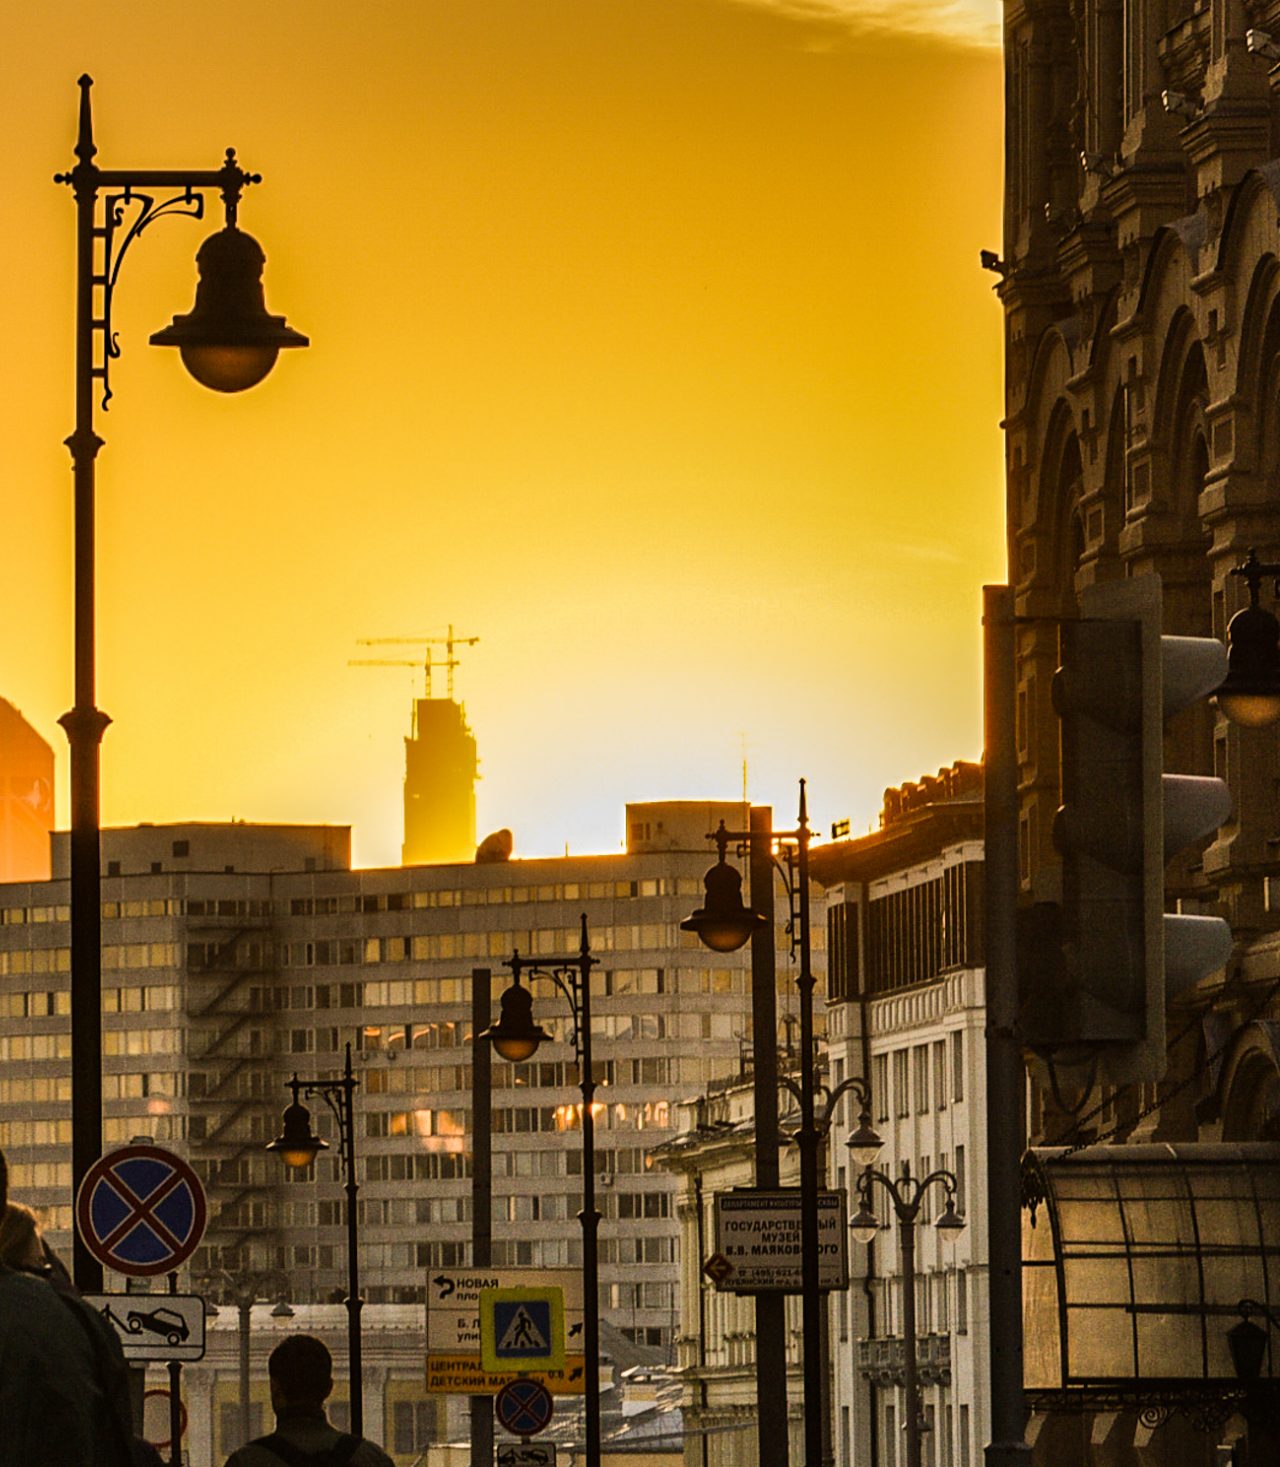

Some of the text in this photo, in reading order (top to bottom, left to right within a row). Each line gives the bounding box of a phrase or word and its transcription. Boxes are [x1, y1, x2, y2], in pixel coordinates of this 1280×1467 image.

[725, 1218, 836, 1231] ГОСУДАРСТВЕЫЙ
[762, 1231, 800, 1243] МУЗЕЙ
[751, 1243, 839, 1256] МАЯКОВОГО
[456, 1278, 499, 1289] НОВАЯ
[456, 1292, 480, 1302] пло
[457, 1318, 481, 1329] Б. Л
[457, 1333, 482, 1344] ули
[431, 1361, 483, 1373] ЦЕНТРАЛ
[431, 1375, 486, 1387] ДЕТСКИЙ
